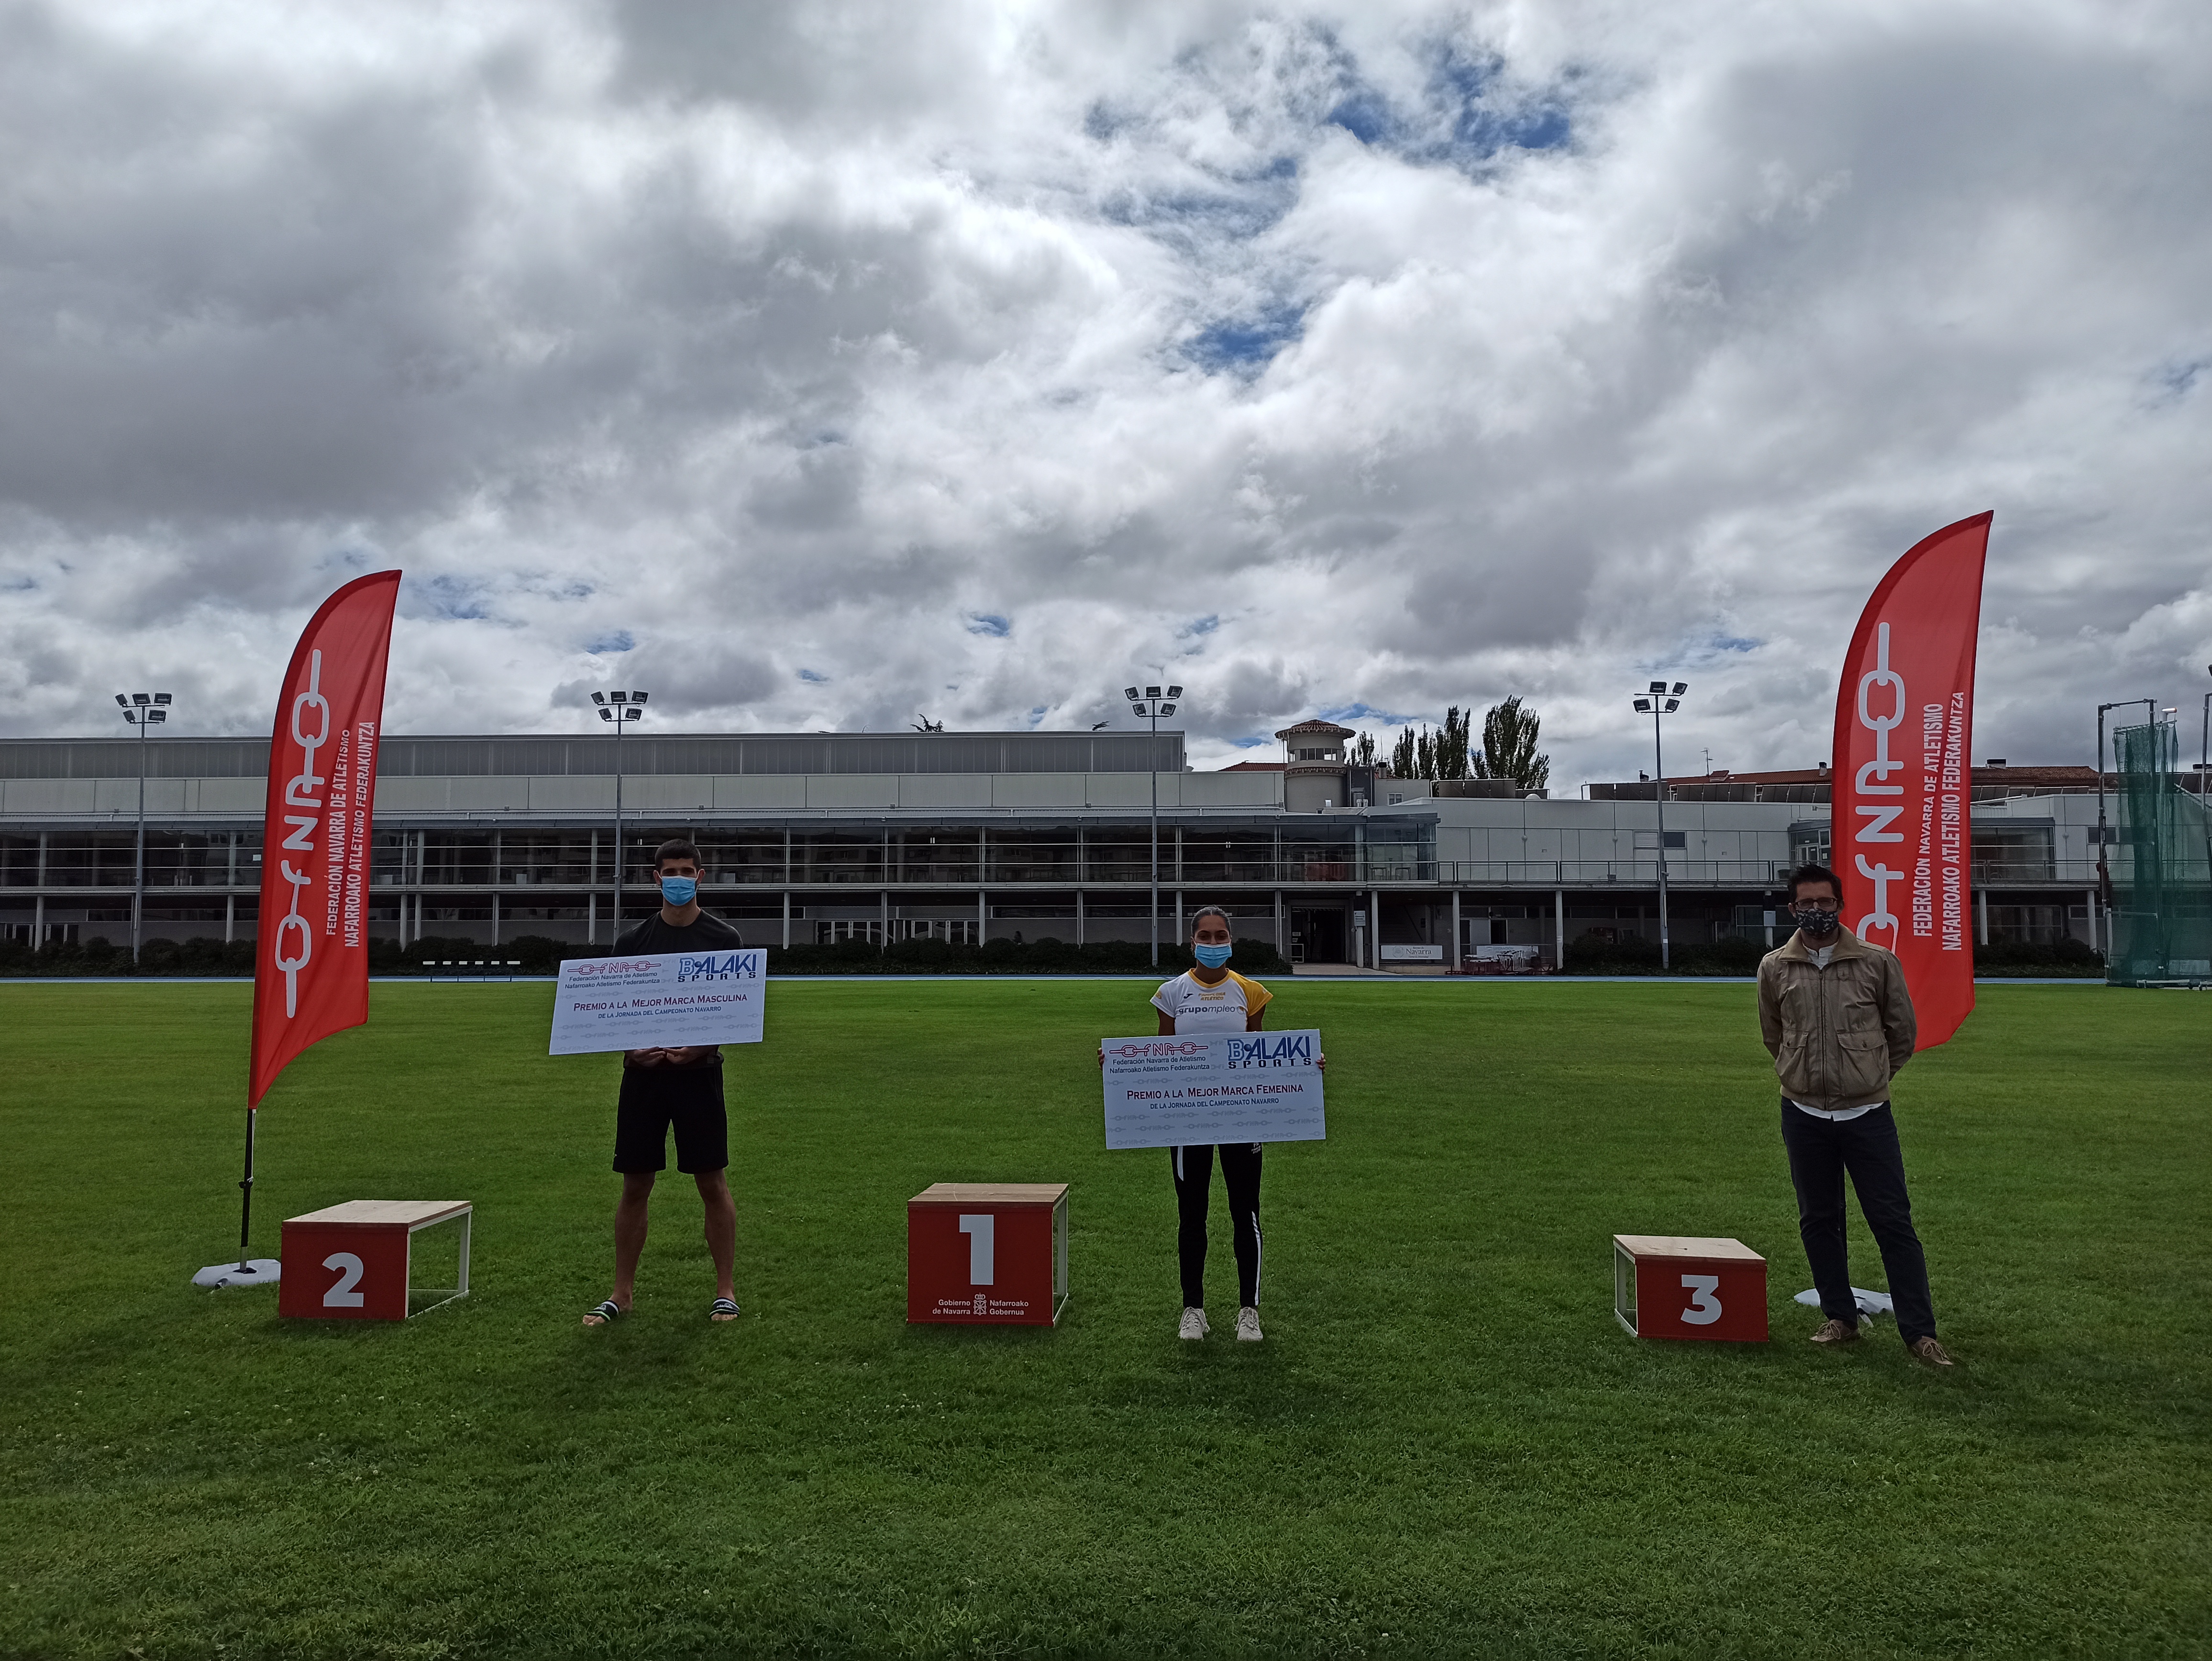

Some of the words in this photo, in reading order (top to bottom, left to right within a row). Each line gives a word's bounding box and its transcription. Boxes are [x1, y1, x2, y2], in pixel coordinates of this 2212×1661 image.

[332, 730, 350, 791] ATLETISMO
[355, 722, 375, 808] FEDERAKUNTZA
[1923, 704, 1943, 773] ATLETISMO
[1942, 692, 1964, 790] FEDERAKUNTZA
[330, 793, 346, 808] DE
[1924, 775, 1937, 792] DE
[328, 811, 346, 862] NAVARRA
[348, 810, 365, 871] ATLETISMO
[1918, 796, 1935, 854] NAVARRA
[1941, 794, 1960, 864] ATLETISMO
[324, 865, 343, 935] FEDERACIÓN
[344, 874, 361, 947] NAFARROAKO
[1913, 858, 1933, 936] FEDERACIÓN
[1942, 867, 1962, 951] NAFARROAKO
[569, 974, 599, 982] Federación
[678, 954, 757, 975] BALAKI
[574, 1002, 607, 1011] PREMIO
[632, 998, 662, 1008] MEJOR
[664, 997, 695, 1005] MARCA
[697, 994, 747, 1004] MASCULINA
[1179, 1005, 1235, 1015] grupompleo
[1228, 1036, 1310, 1061] BALAKI
[1127, 1090, 1161, 1100] PREMIO
[1164, 1090, 1170, 1098] A
[1172, 1089, 1183, 1098] LA
[1188, 1087, 1219, 1097] MEJOR
[1221, 1086, 1254, 1096] MARCA
[1256, 1084, 1304, 1094] FEMENINA
[1209, 1099, 1250, 1107] CAMPEONATO
[959, 1215, 994, 1285] 1
[322, 1252, 364, 1307] 2
[1681, 1274, 1722, 1325] 3
